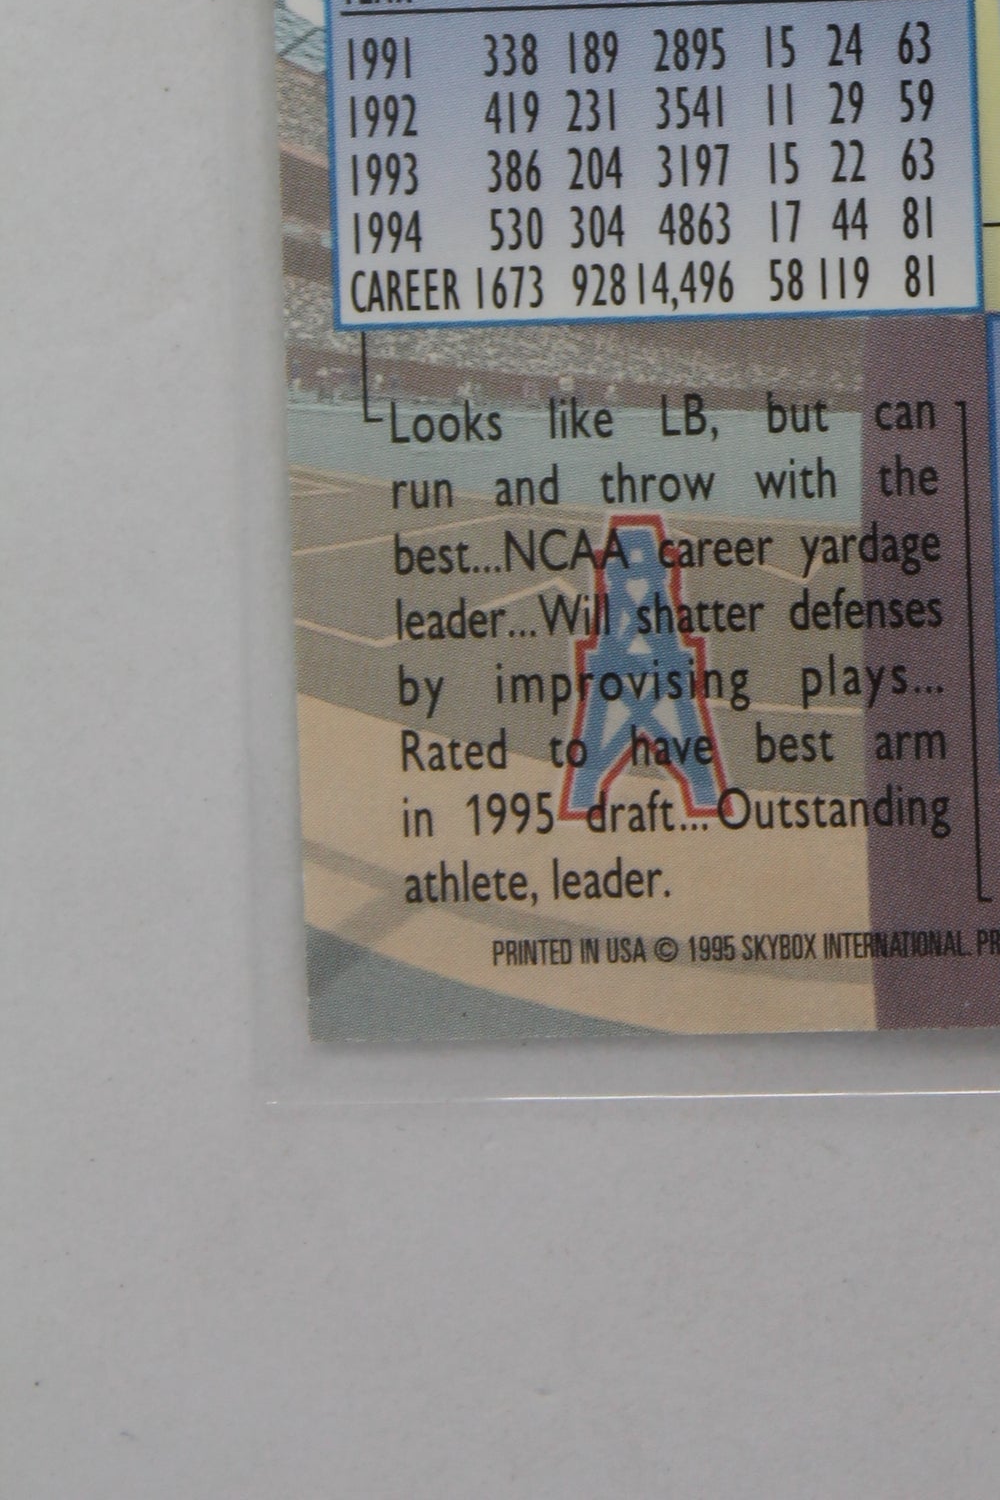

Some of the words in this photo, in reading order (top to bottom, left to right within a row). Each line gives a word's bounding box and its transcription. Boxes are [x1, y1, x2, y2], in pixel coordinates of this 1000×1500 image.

[347, 37, 411, 80] 1991
[484, 33, 537, 77] 338
[568, 30, 618, 74] 189
[654, 26, 726, 72] 2895
[766, 26, 795, 68] 15
[827, 22, 863, 67] 24
[899, 21, 931, 64] 63
[350, 95, 417, 138] 1992
[485, 90, 538, 135] 419
[566, 88, 616, 131] 231
[656, 85, 723, 130] 3541
[768, 84, 793, 126] 11
[829, 81, 863, 125] 29
[901, 80, 933, 122] 59
[352, 153, 418, 196] 1993
[487, 149, 541, 192] 386
[568, 146, 622, 190] 204
[658, 143, 729, 188] 3197
[770, 142, 798, 185] 15
[831, 139, 865, 183] 22
[902, 138, 934, 181] 63
[354, 211, 422, 254] 1994
[490, 207, 543, 251] 530
[570, 204, 625, 249] 304
[659, 202, 730, 246] 4863
[771, 200, 800, 242] 17
[832, 198, 868, 241] 44
[904, 196, 932, 239] 81
[351, 267, 459, 313] CAREER
[477, 265, 543, 310] 1673
[573, 263, 626, 307] 928
[638, 260, 733, 310] 14,496
[770, 258, 803, 302] 58
[821, 257, 869, 299] 119
[905, 255, 934, 297] 81
[390, 401, 502, 444] Looks
[549, 396, 613, 439] like
[662, 393, 719, 441] LB,
[767, 392, 828, 434] but
[875, 399, 936, 431] can
[392, 477, 452, 510] run
[495, 464, 559, 507] and
[600, 461, 714, 503] throw
[755, 457, 837, 499] with
[878, 454, 938, 497] the
[658, 530, 773, 567] career
[801, 522, 941, 578] yardage
[637, 593, 764, 634] shatter
[790, 588, 942, 631] defenses
[399, 664, 443, 718] by
[497, 658, 751, 715] improvising
[801, 654, 943, 709] plays...
[402, 727, 508, 772] Rated
[549, 736, 588, 768] to
[632, 724, 713, 765] have
[756, 722, 834, 763] best
[875, 729, 945, 761] arm
[403, 797, 433, 838] in
[467, 793, 554, 836] 1995
[405, 859, 538, 907] athlete,
[553, 856, 670, 900] leader.
[494, 939, 572, 966] PRINTED
[580, 938, 600, 965] IN
[607, 937, 646, 964] USA
[689, 935, 735, 963] 1995
[742, 933, 817, 962] SKYBOX
